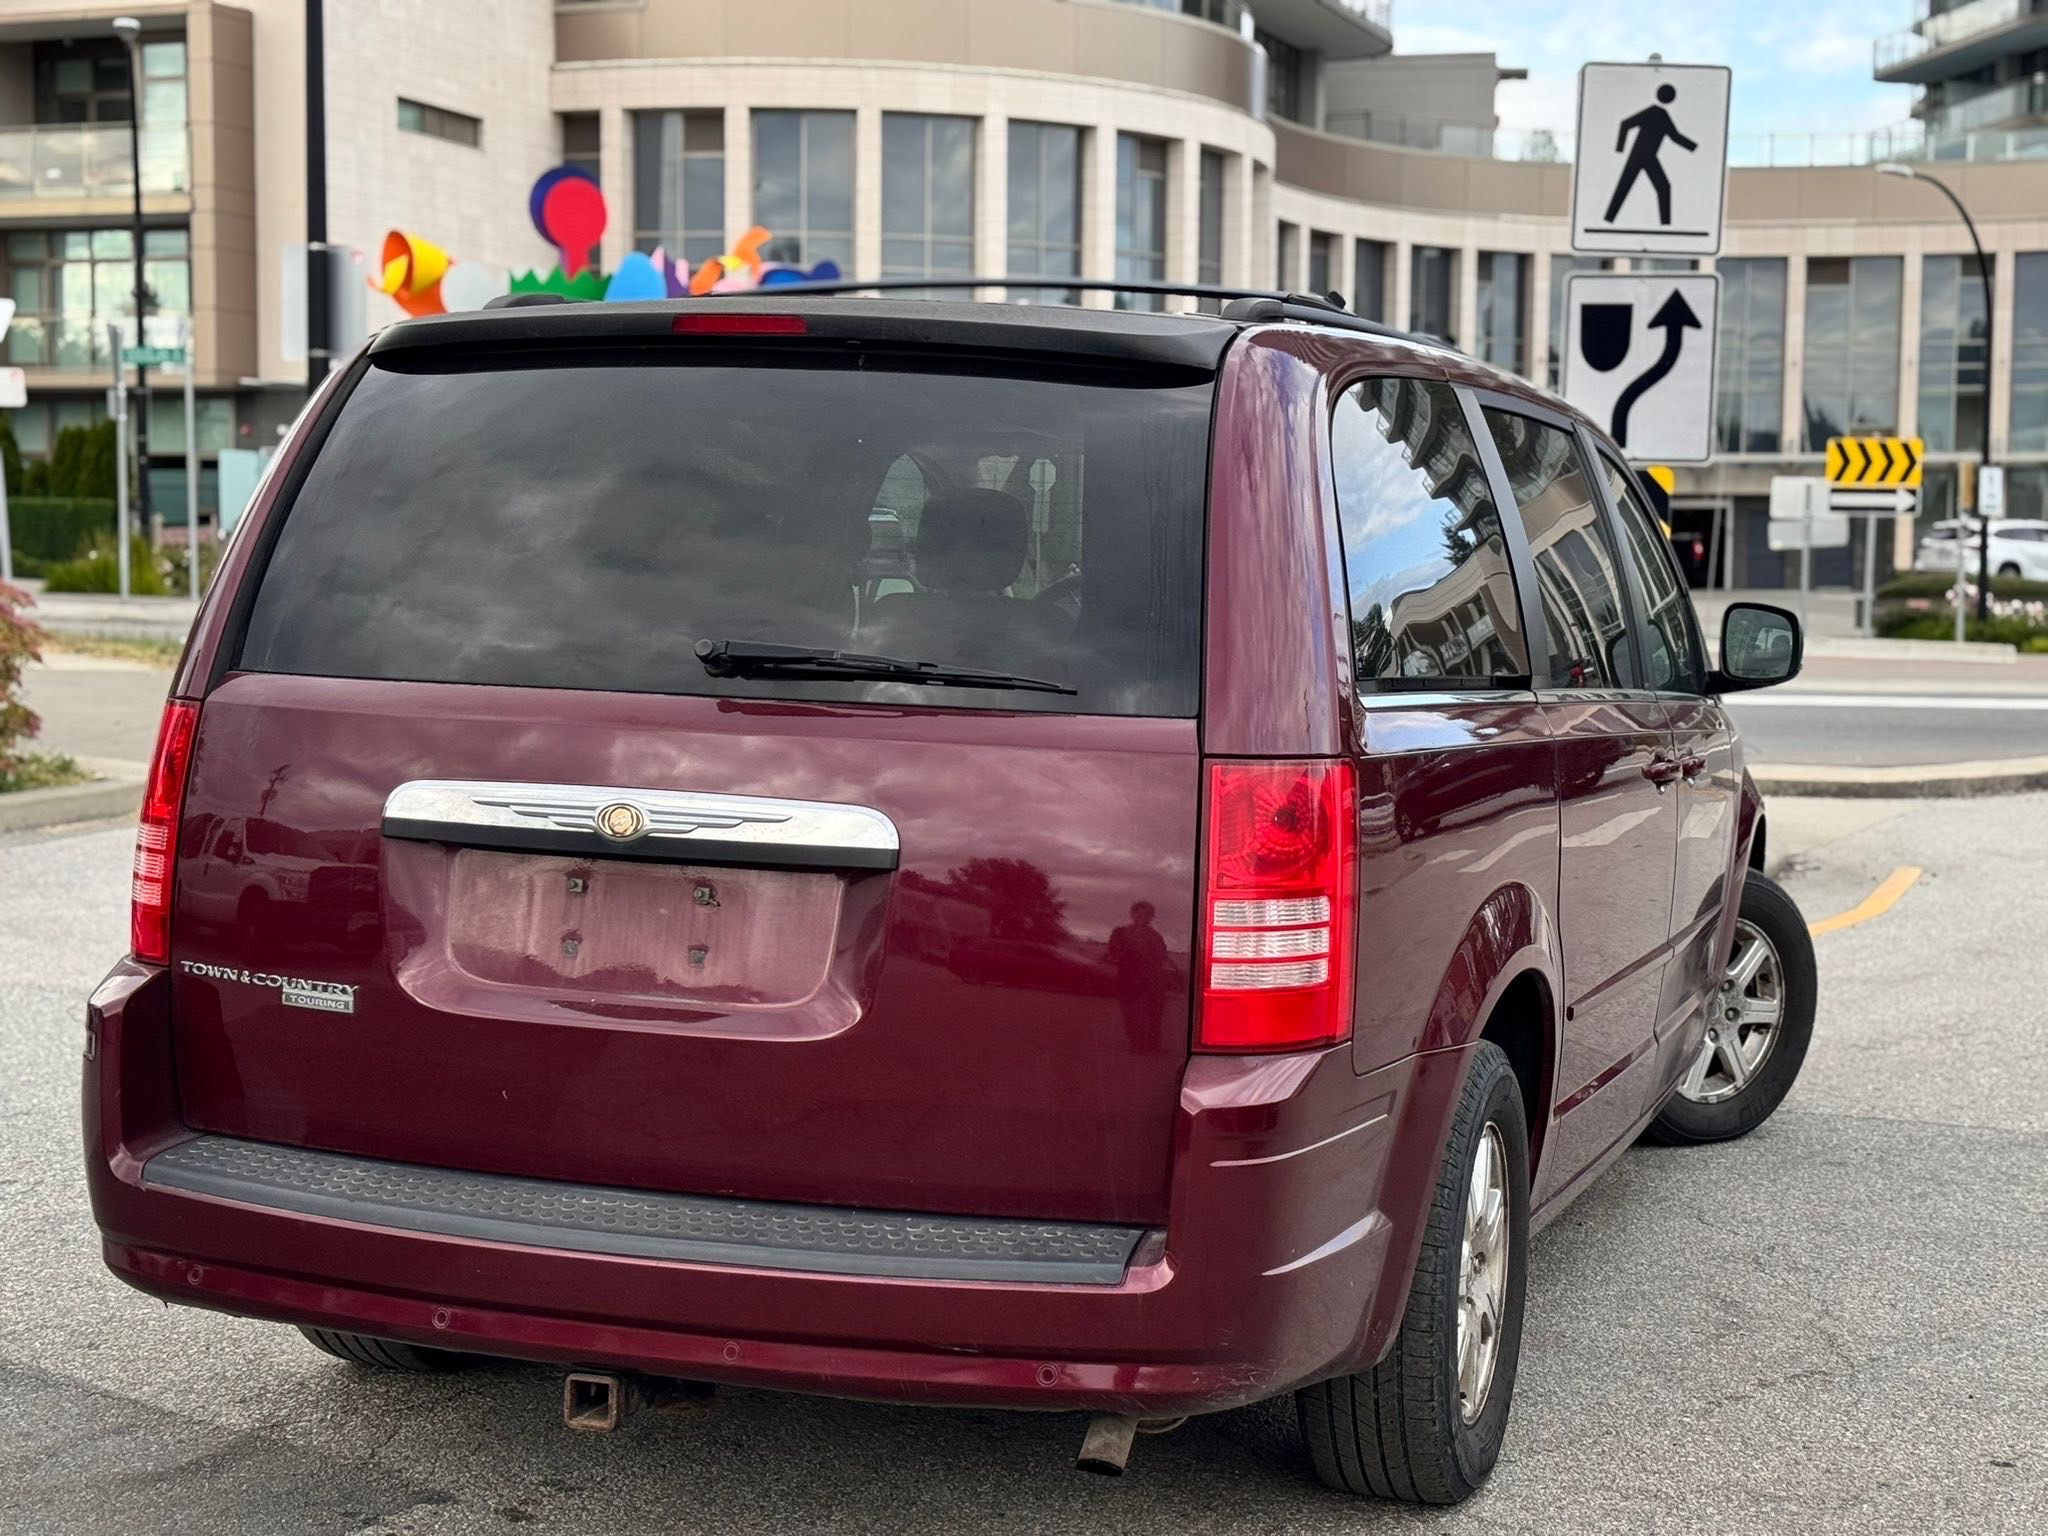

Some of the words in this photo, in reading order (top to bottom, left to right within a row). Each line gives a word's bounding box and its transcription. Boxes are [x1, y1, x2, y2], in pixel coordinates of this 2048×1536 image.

[180, 960, 238, 981] TOWN
[252, 973, 359, 996] COUNTRY
[289, 994, 345, 1009] TOURING
